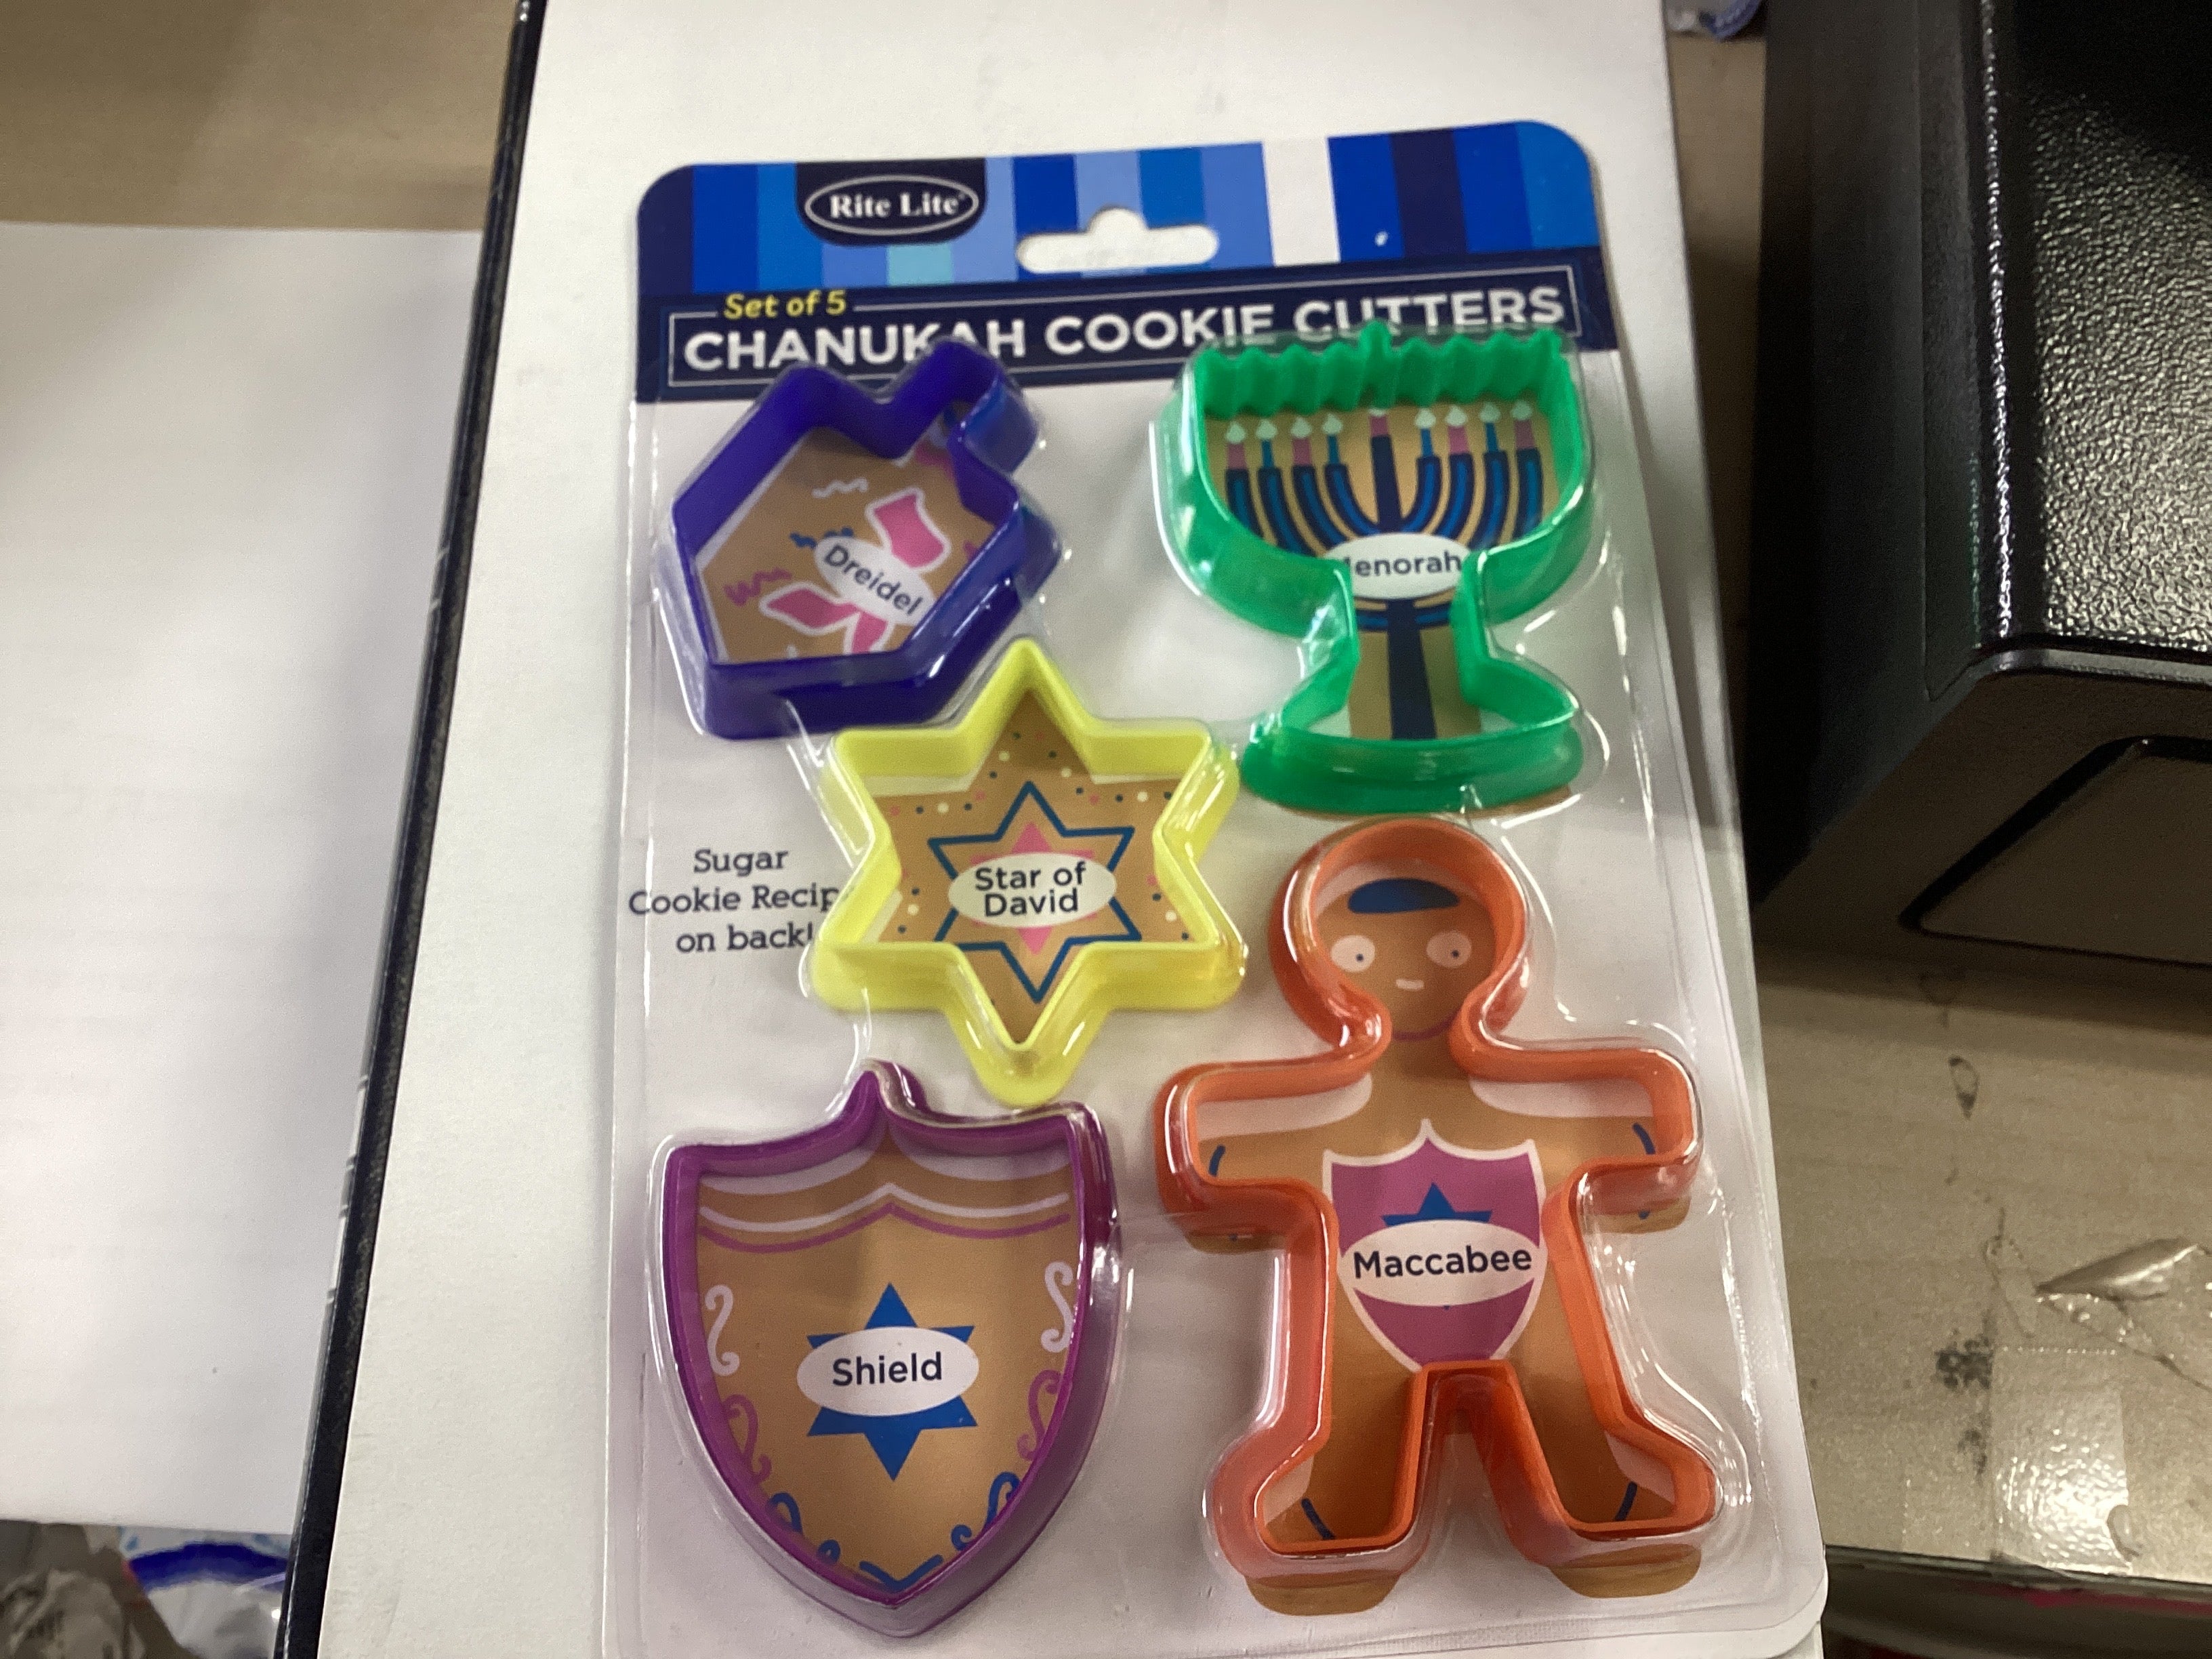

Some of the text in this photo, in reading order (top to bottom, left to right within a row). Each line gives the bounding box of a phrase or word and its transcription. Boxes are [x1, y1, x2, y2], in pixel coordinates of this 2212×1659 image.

[830, 192, 892, 218] Rite
[723, 289, 846, 320] Set of 5
[1044, 304, 1277, 355] COOKIE
[1292, 285, 1565, 342] CUTTERS
[1344, 549, 1462, 577] enorah
[824, 544, 924, 616] Dreidel
[693, 848, 789, 877] Sugar
[975, 860, 1087, 891] Star of
[629, 882, 840, 916] Cookie Recip
[984, 887, 1079, 917] David
[676, 933, 716, 953] on
[1353, 1245, 1532, 1279] Maccabee
[832, 1351, 942, 1387] Shield
